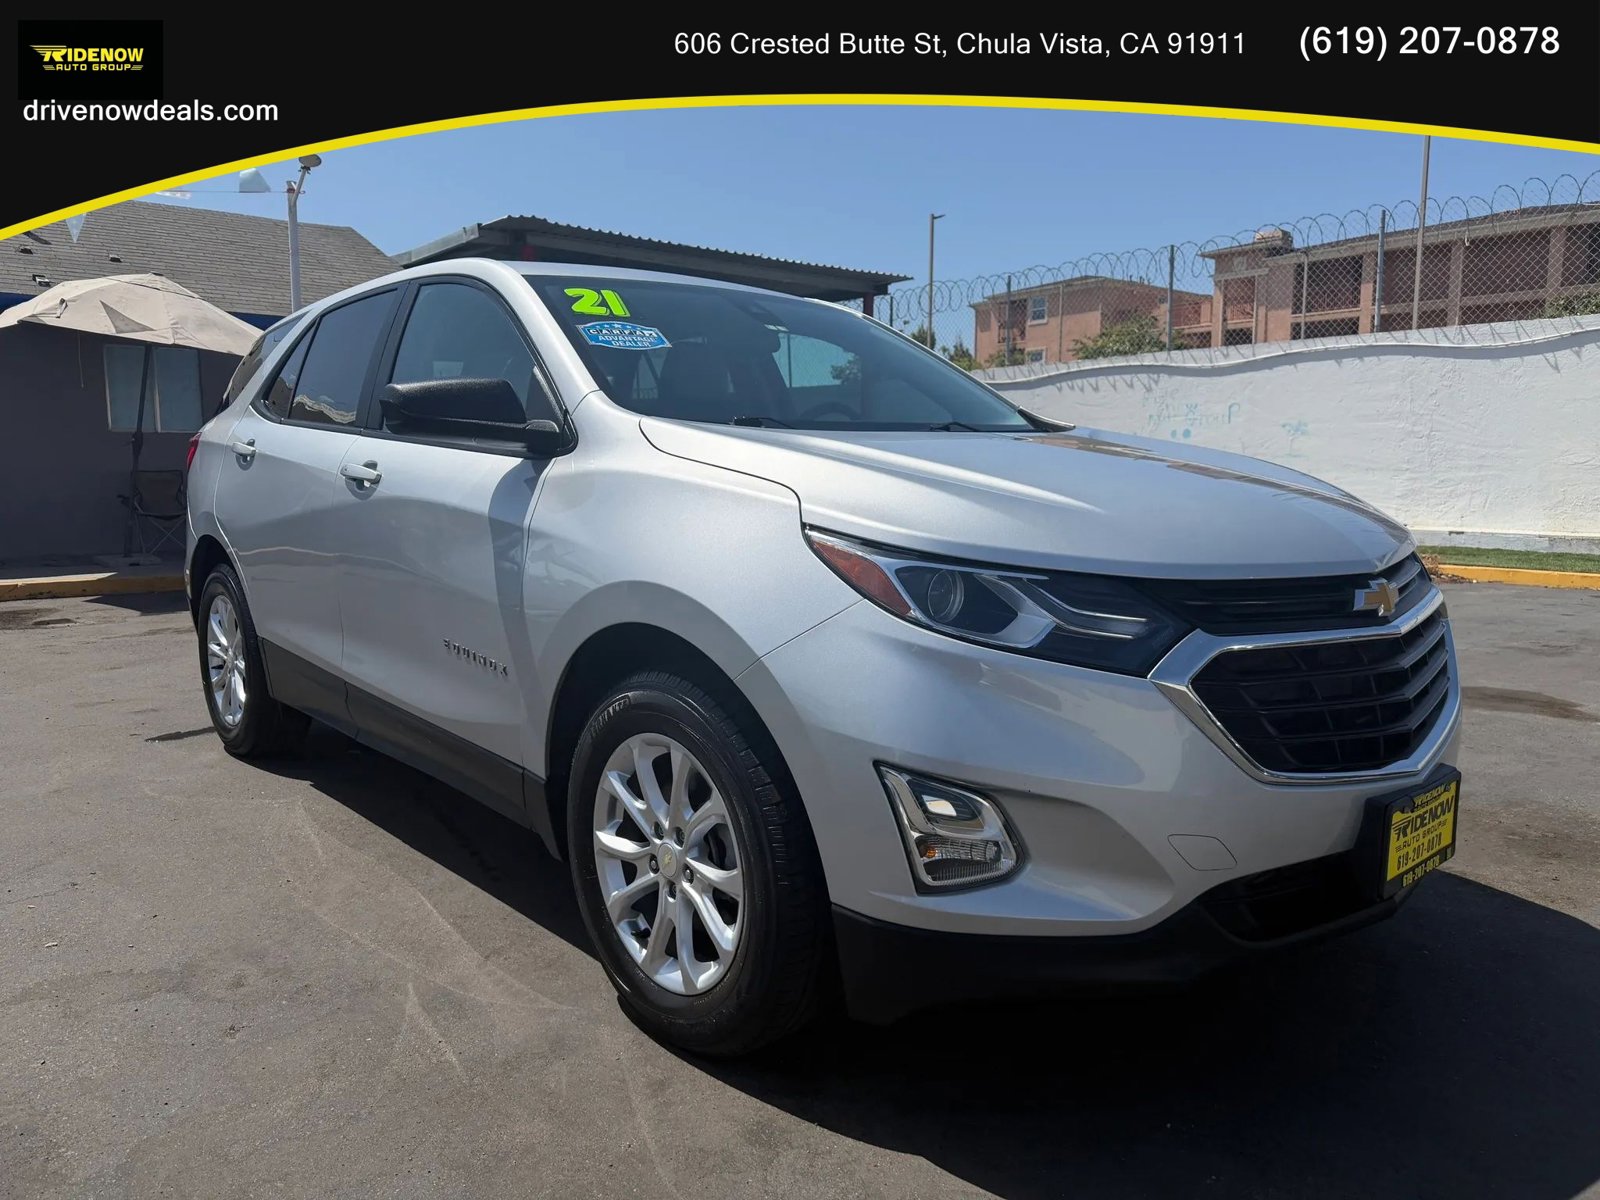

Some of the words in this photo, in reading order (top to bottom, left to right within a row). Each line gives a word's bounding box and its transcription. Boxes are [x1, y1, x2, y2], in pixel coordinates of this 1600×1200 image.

[563, 287, 631, 318] 21
[598, 334, 657, 343] ADVANTAGE
[611, 339, 652, 348] DEALER
[1392, 796, 1455, 842] RIDENOW
